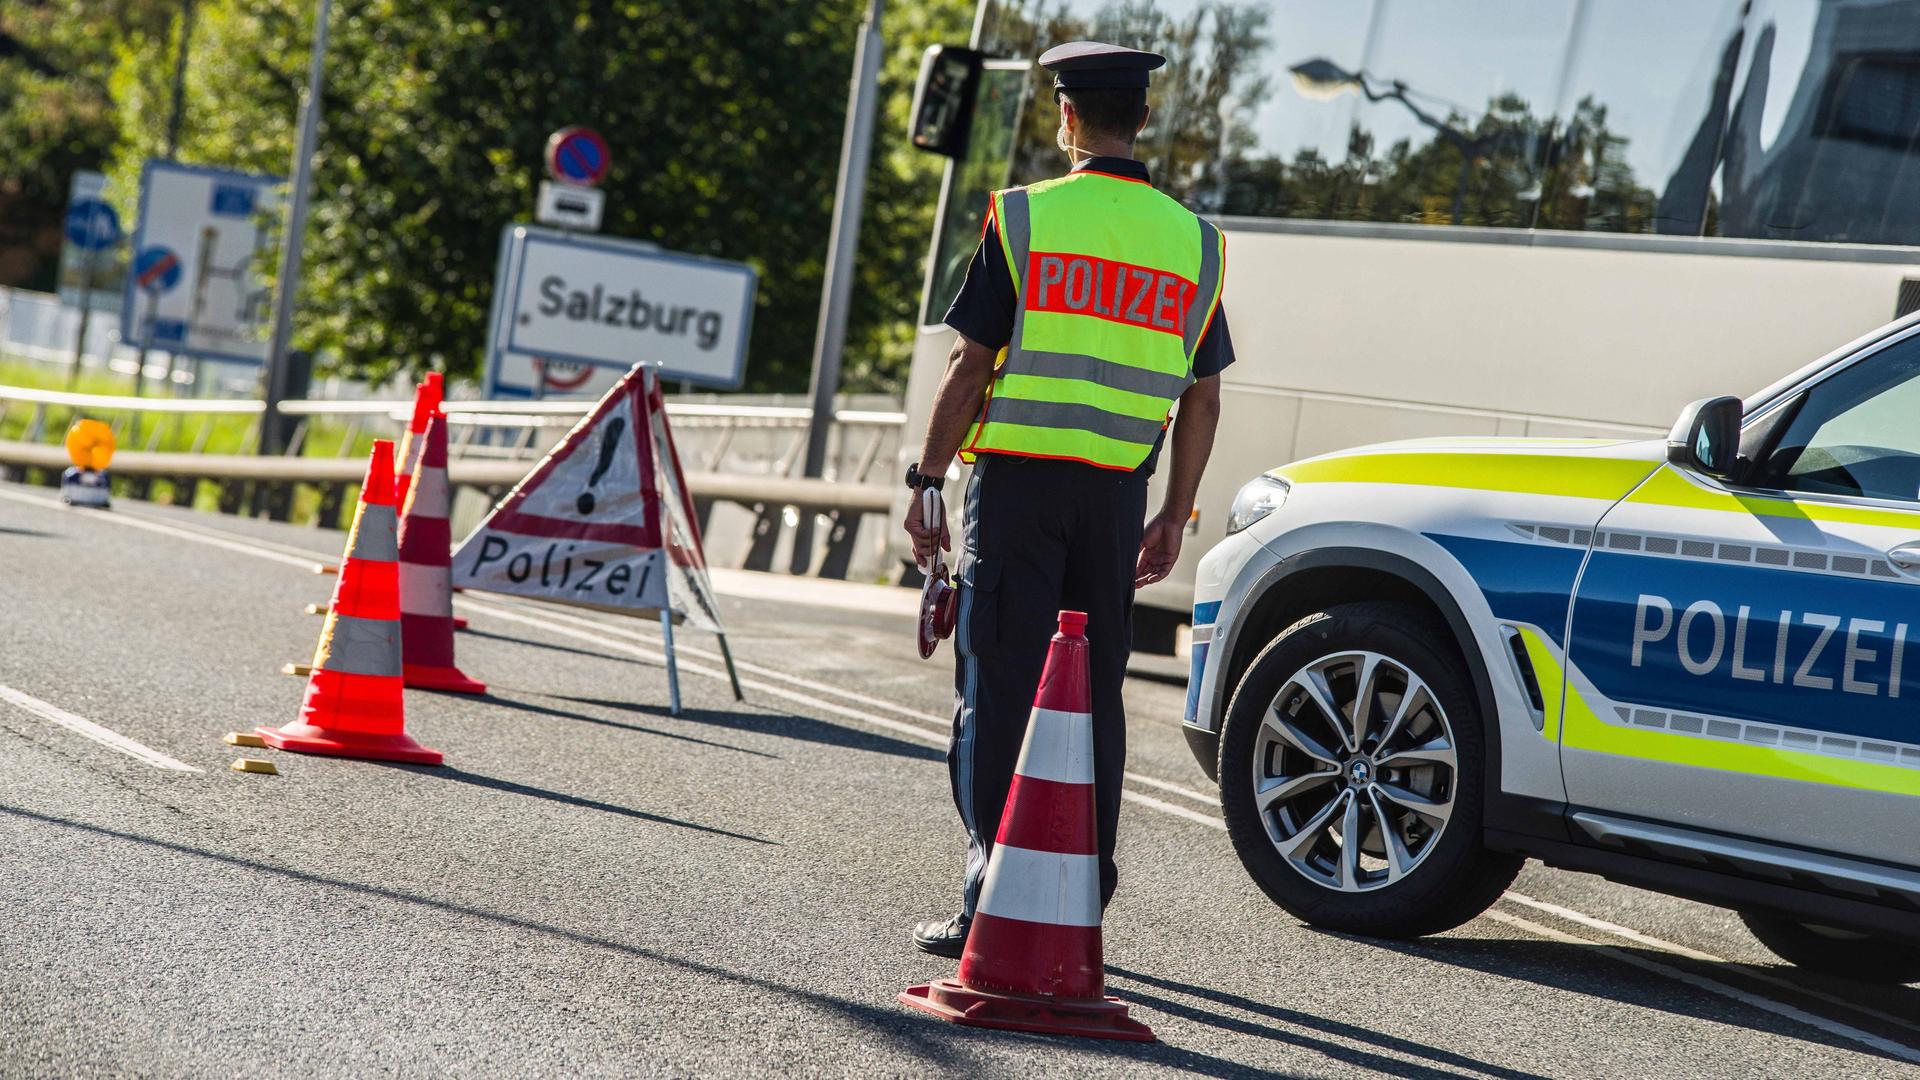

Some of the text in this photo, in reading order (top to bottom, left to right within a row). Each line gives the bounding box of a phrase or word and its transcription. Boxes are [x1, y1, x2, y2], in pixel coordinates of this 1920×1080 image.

[537, 274, 723, 352] Salzburg
[469, 535, 656, 600] Polizei
[1630, 593, 1909, 699] POLIZEI
